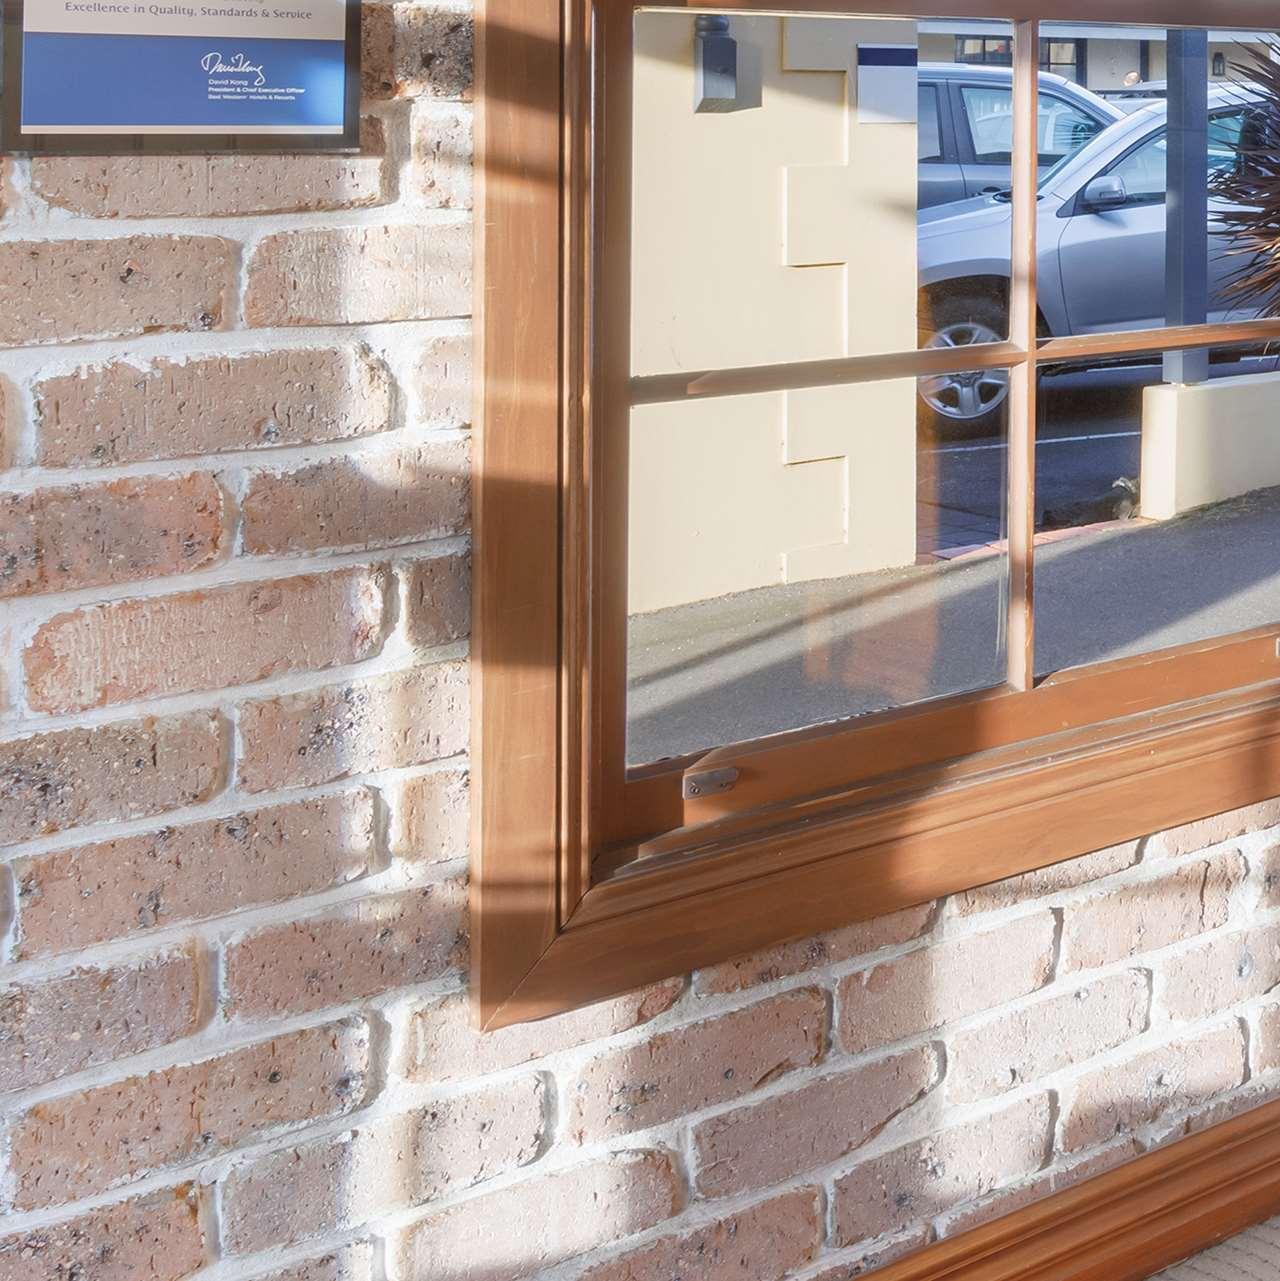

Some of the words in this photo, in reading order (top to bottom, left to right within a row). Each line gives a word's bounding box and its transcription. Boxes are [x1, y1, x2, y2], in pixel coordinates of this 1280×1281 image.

[64, 2, 130, 14] Excellence
[134, 3, 146, 14] in
[148, 4, 197, 18] Quality,
[200, 6, 258, 19] Standards
[260, 8, 270, 18] &
[273, 9, 313, 20] Service
